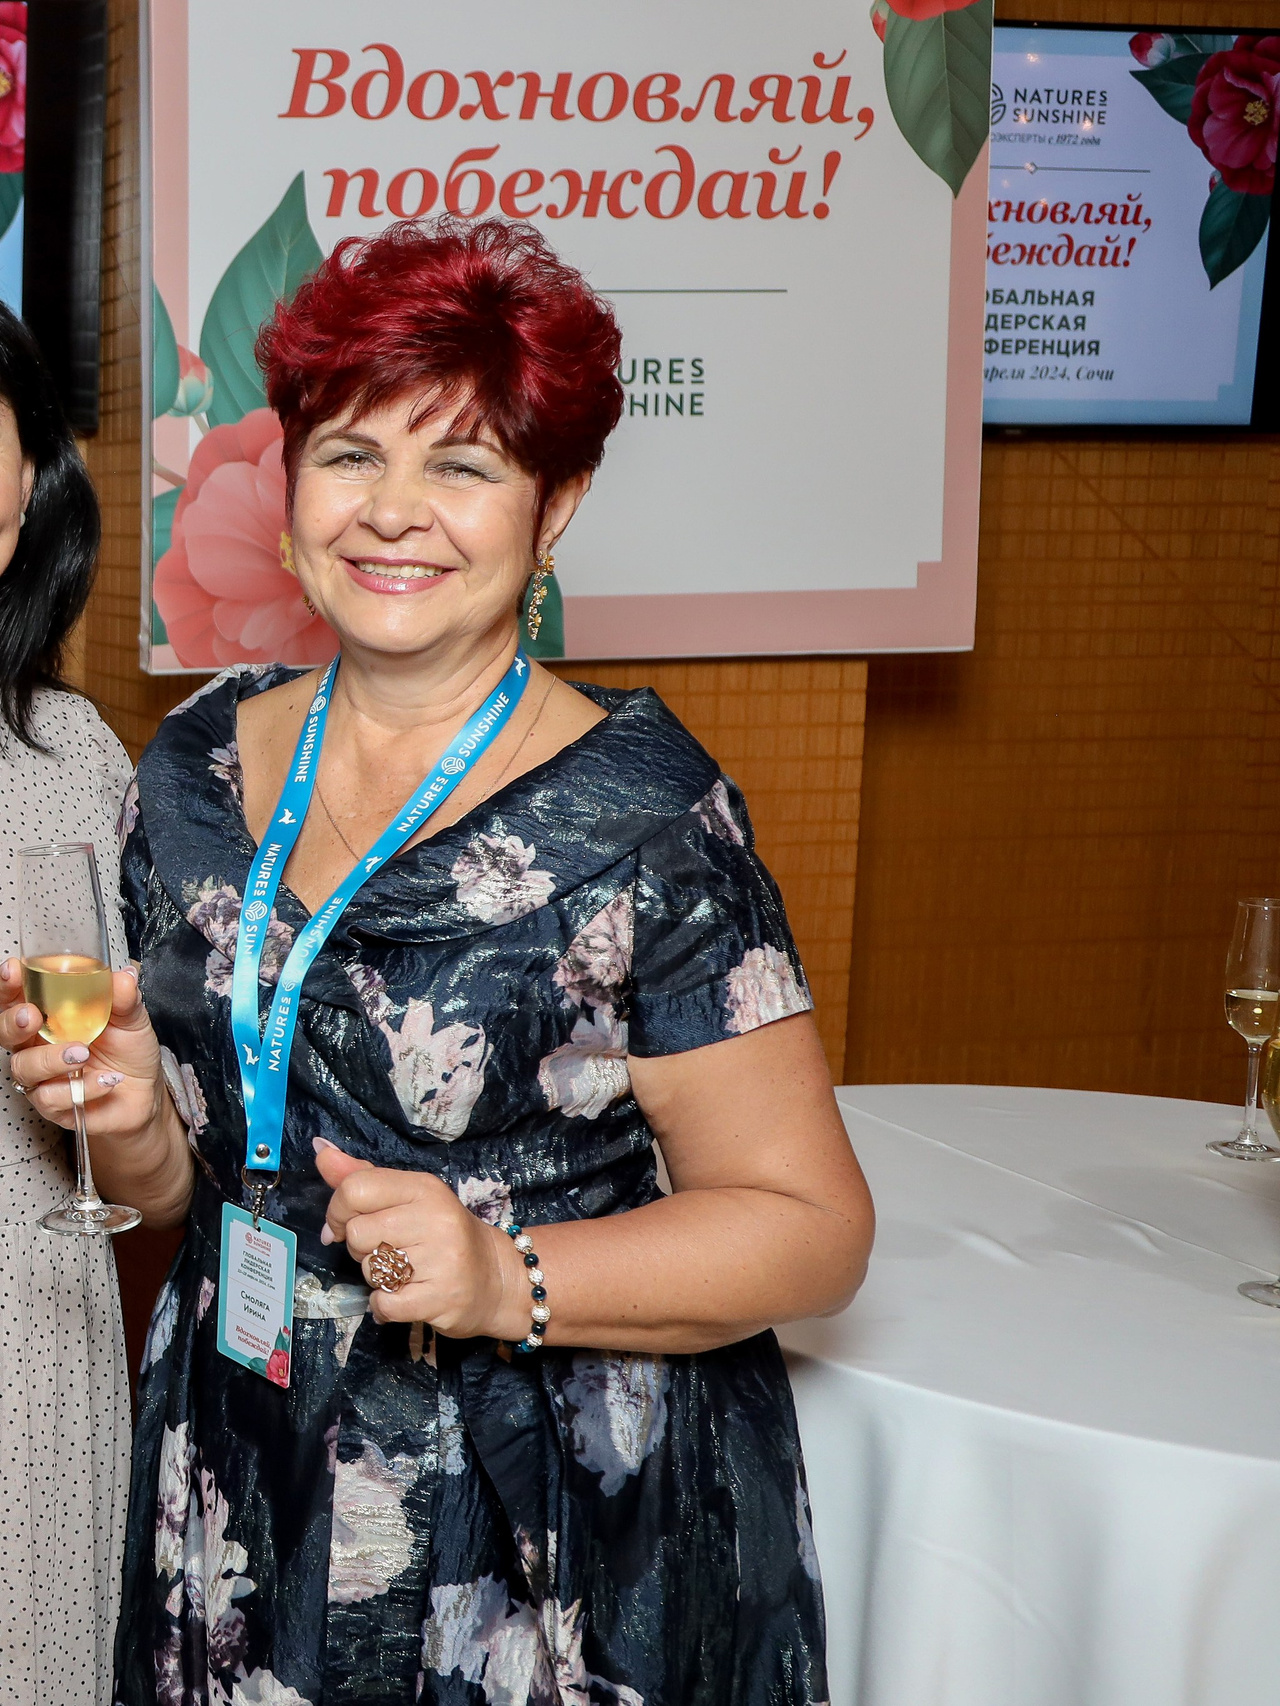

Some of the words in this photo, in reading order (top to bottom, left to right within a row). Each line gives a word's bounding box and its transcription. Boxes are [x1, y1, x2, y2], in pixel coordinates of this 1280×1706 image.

[277, 43, 876, 141] Вдохновляй,
[1013, 88, 1108, 106] NATURES
[1013, 108, 1106, 125] SUNSHINE
[322, 144, 843, 221] побеждай!
[988, 192, 1152, 233] хновляй,
[987, 232, 1137, 268] еждай!
[986, 288, 1095, 307] БАЛЬНАЯ
[985, 313, 1087, 333] ДЕРСКАЯ
[984, 338, 1101, 358] ФЕРЕНЦИЯ
[617, 357, 705, 385] URES
[1076, 365, 1115, 382] Сочи
[629, 393, 705, 417] HINE
[294, 715, 319, 783] SUNSHINE
[396, 776, 450, 833] NATURES
[458, 691, 510, 758] SUNSHINE
[253, 843, 283, 897] NATURES
[267, 996, 292, 1072] NATURES
